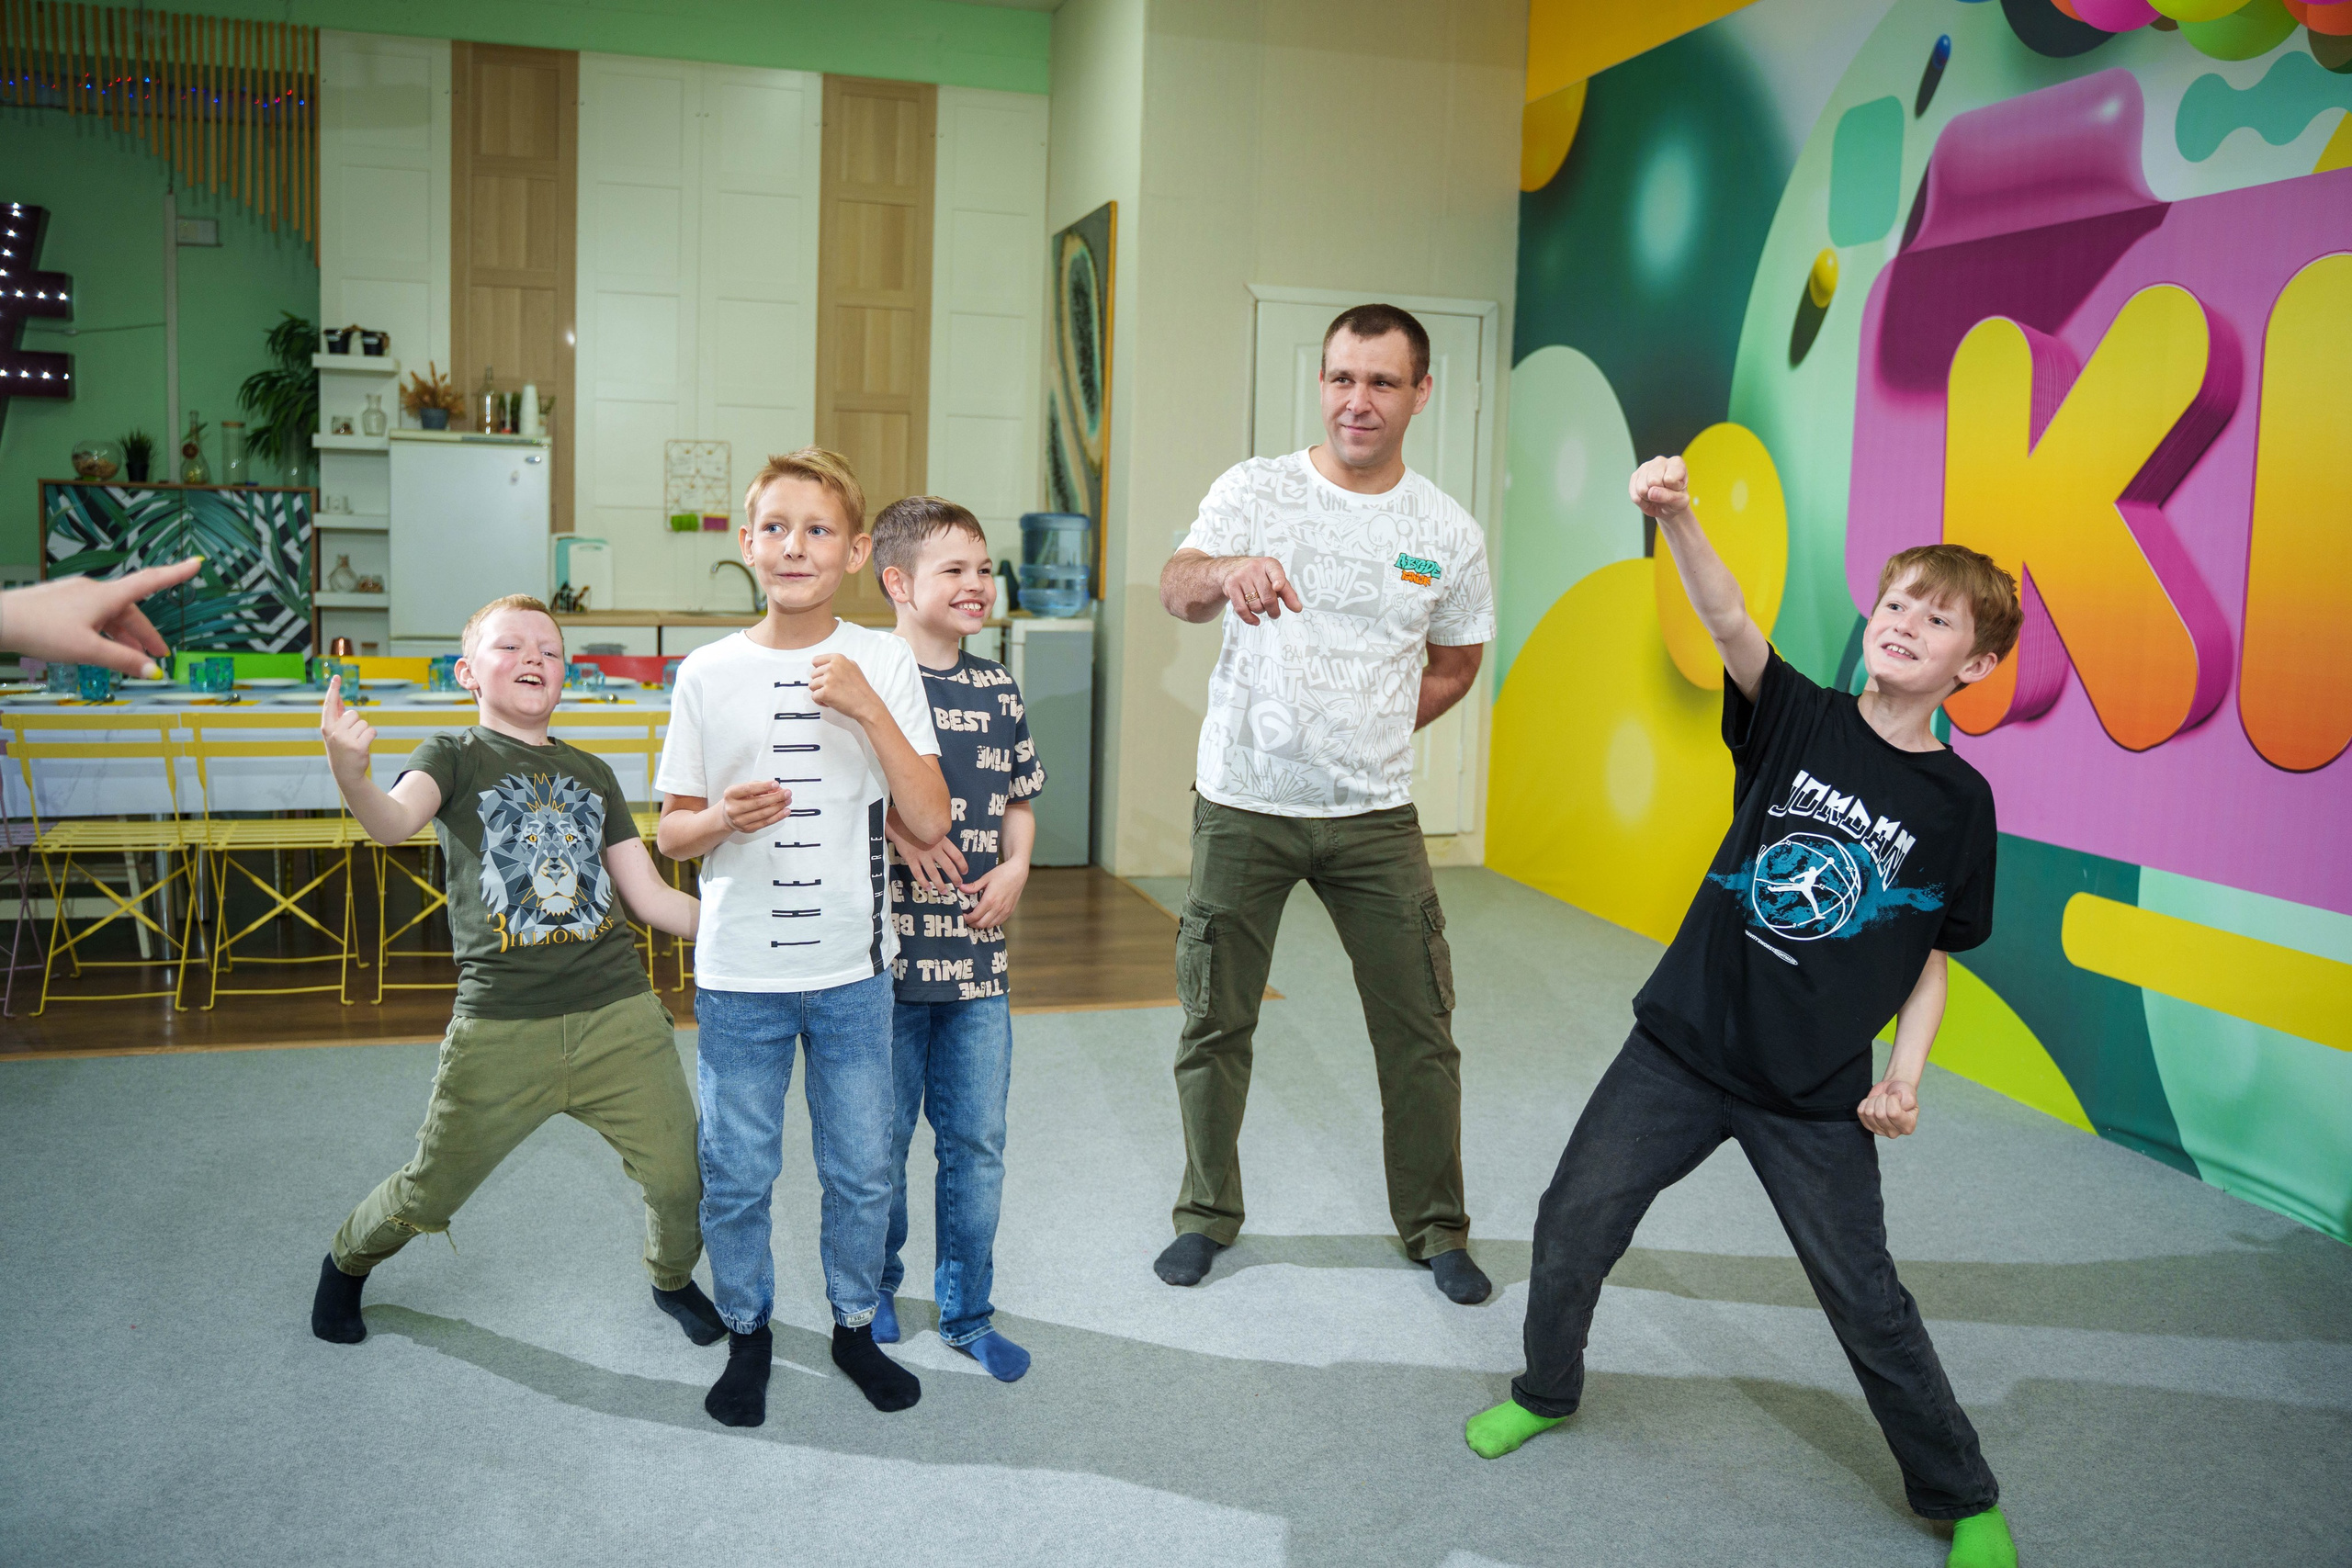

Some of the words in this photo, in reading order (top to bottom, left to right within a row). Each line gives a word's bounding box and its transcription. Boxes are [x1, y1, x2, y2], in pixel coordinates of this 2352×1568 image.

[1394, 553, 1442, 580] ABCDE
[1233, 648, 1304, 705] GIANT
[933, 706, 990, 733] BEST
[1768, 770, 1916, 892] JORDAN
[487, 913, 615, 953] BILLIONARE
[923, 914, 968, 937] THE
